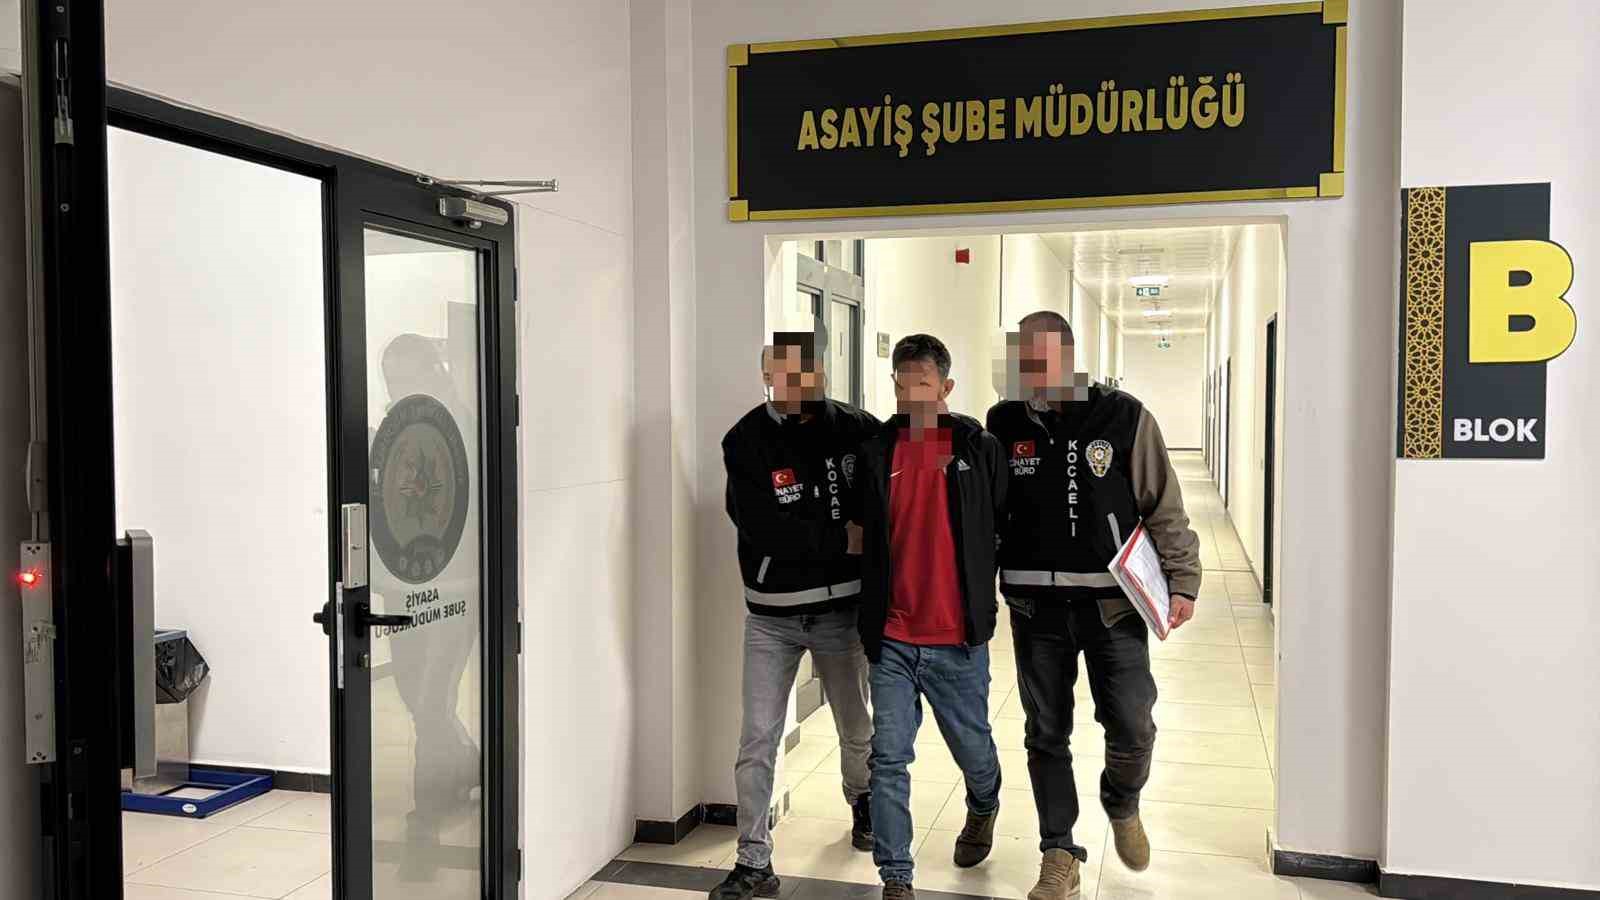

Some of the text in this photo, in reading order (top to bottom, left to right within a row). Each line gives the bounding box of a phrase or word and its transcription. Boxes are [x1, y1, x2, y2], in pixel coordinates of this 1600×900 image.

[798, 72, 1245, 157] ASAYİŞ ŞUBE MÜDÜRLÜĞÜ
[1469, 239, 1577, 364] B
[1453, 418, 1538, 442] BLOK
[825, 458, 841, 519] KOCAE
